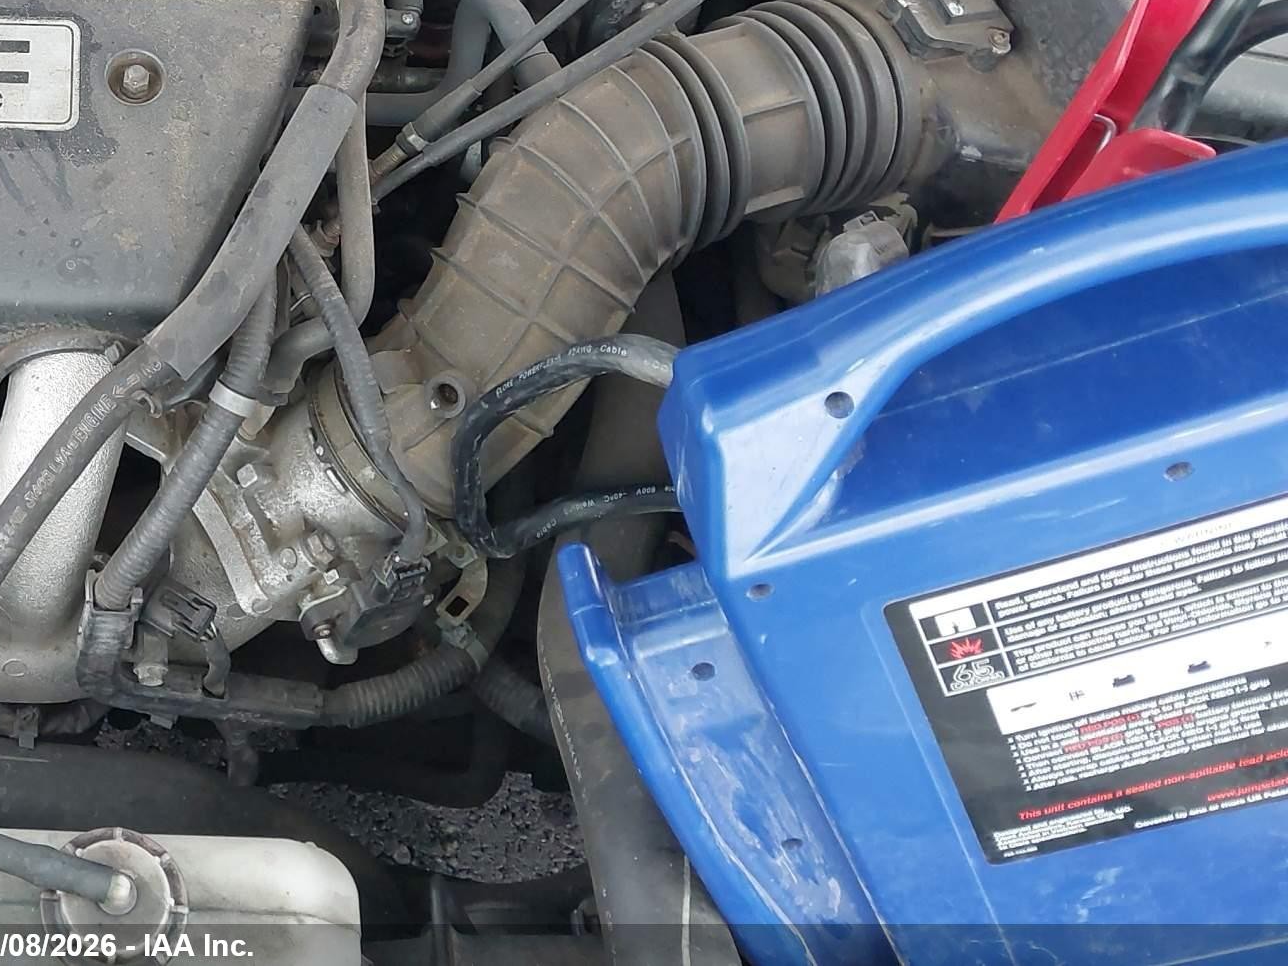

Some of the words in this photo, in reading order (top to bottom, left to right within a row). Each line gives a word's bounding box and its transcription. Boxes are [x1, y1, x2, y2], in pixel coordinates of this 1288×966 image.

[599, 343, 628, 358] Cable
[76, 393, 117, 445] ENGINE
[535, 518, 558, 540] Cable
[1022, 580, 1079, 602] understand
[1078, 574, 1100, 587] and
[1098, 565, 1131, 581] follow
[1130, 548, 1190, 572] instructions
[1189, 540, 1221, 556] found
[949, 657, 995, 683] 65
[1017, 739, 1032, 749] Do
[1032, 735, 1050, 745] not
[1018, 808, 1042, 820] This
[1042, 802, 1065, 814] unit
[1065, 790, 1113, 809] contains
[1113, 788, 1123, 798] a
[1123, 778, 1163, 795] sealed
[1162, 760, 1237, 786] non-spillable
[1237, 753, 1265, 768] lead
[1134, 813, 1174, 829] Covered
